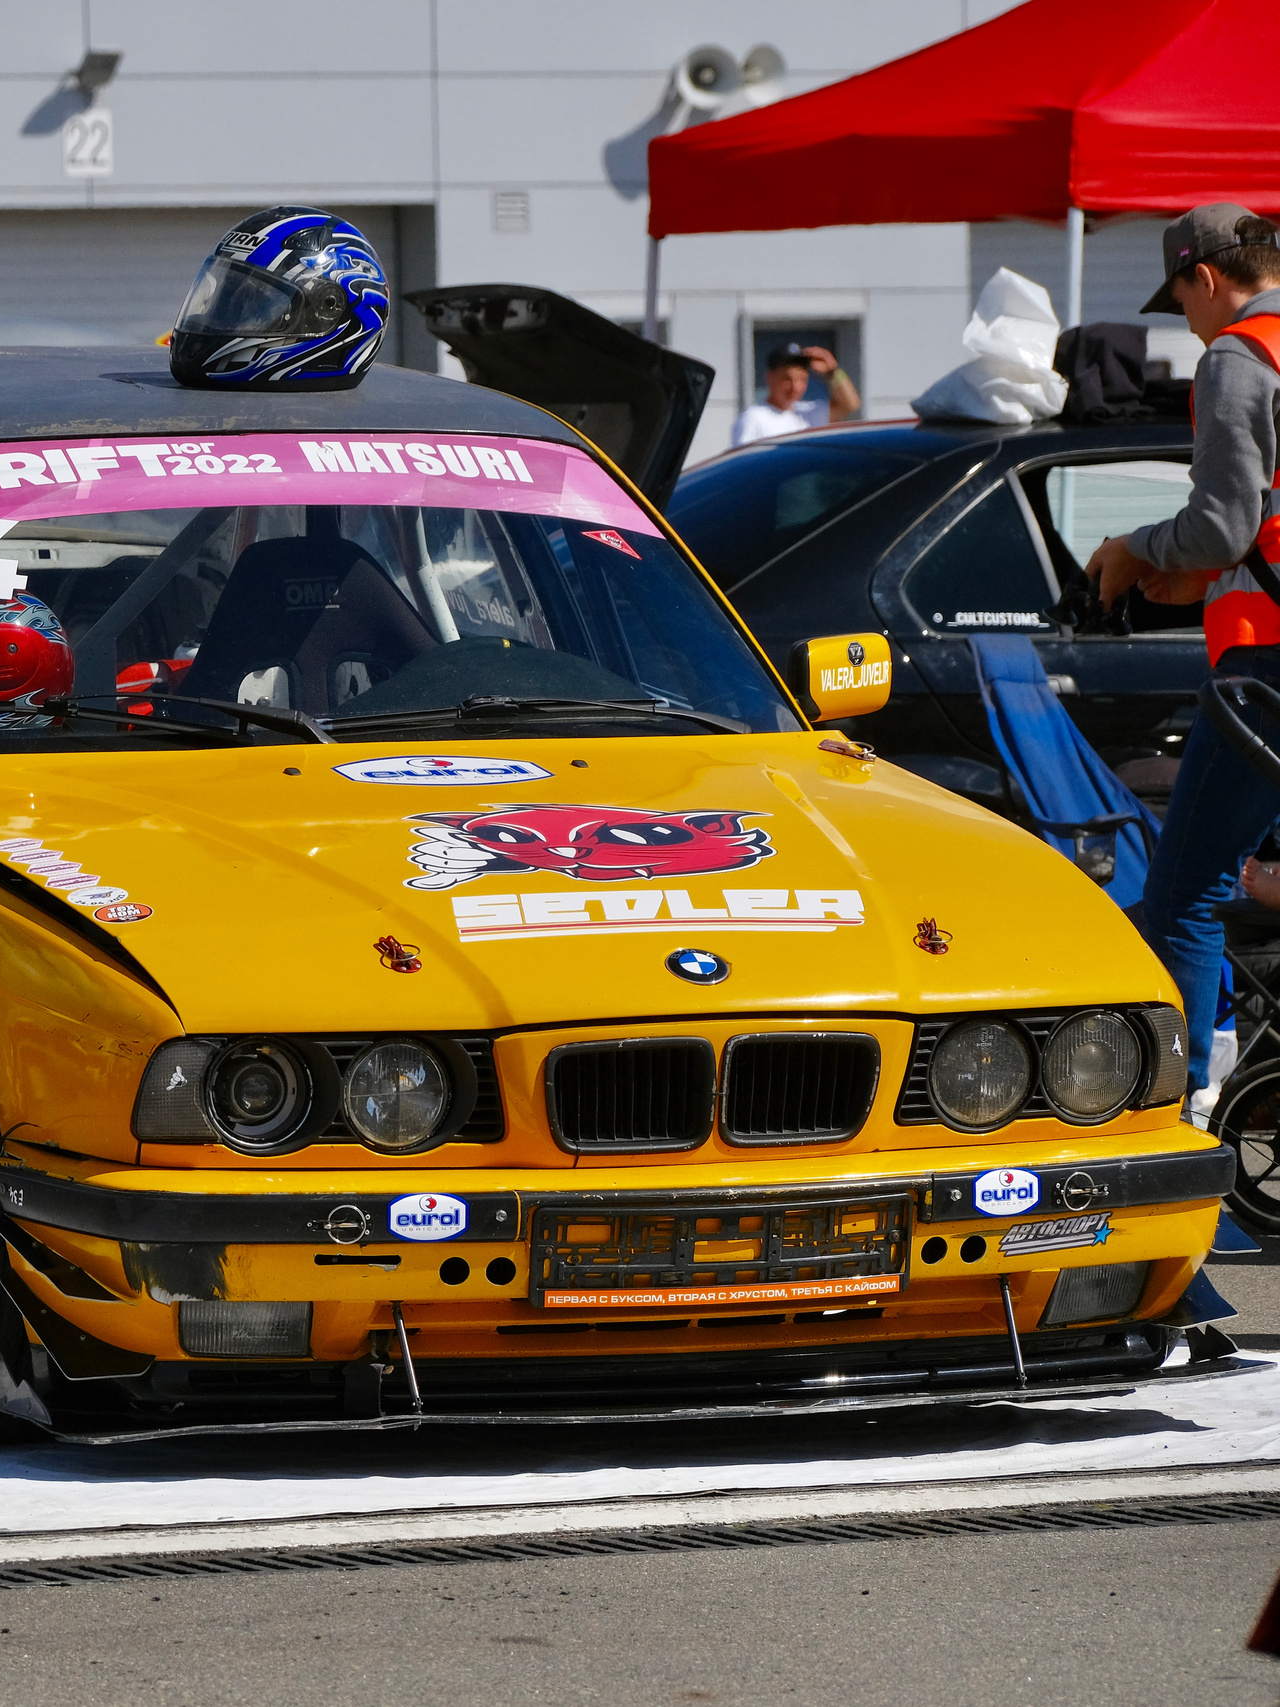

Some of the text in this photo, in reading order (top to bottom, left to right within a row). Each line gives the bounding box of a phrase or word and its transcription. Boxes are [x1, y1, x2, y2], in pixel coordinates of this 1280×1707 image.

[65, 119, 109, 167] 22
[221, 231, 268, 252] OLAN
[163, 453, 283, 475] 2022
[298, 441, 534, 483] MATSURI
[821, 661, 890, 692] VALERA_JUVELIR
[361, 764, 534, 779] eurol
[981, 1182, 1034, 1202] eurol
[396, 1208, 461, 1227] eurol
[1000, 1212, 1112, 1244] АВТОСПОРТ
[547, 1279, 897, 1304] ПЕРВАЯ С БУКСОМ, ВТОРАЯ С ХРУСТОМ, ТРЕТЬЯ С КАЙФОМ
